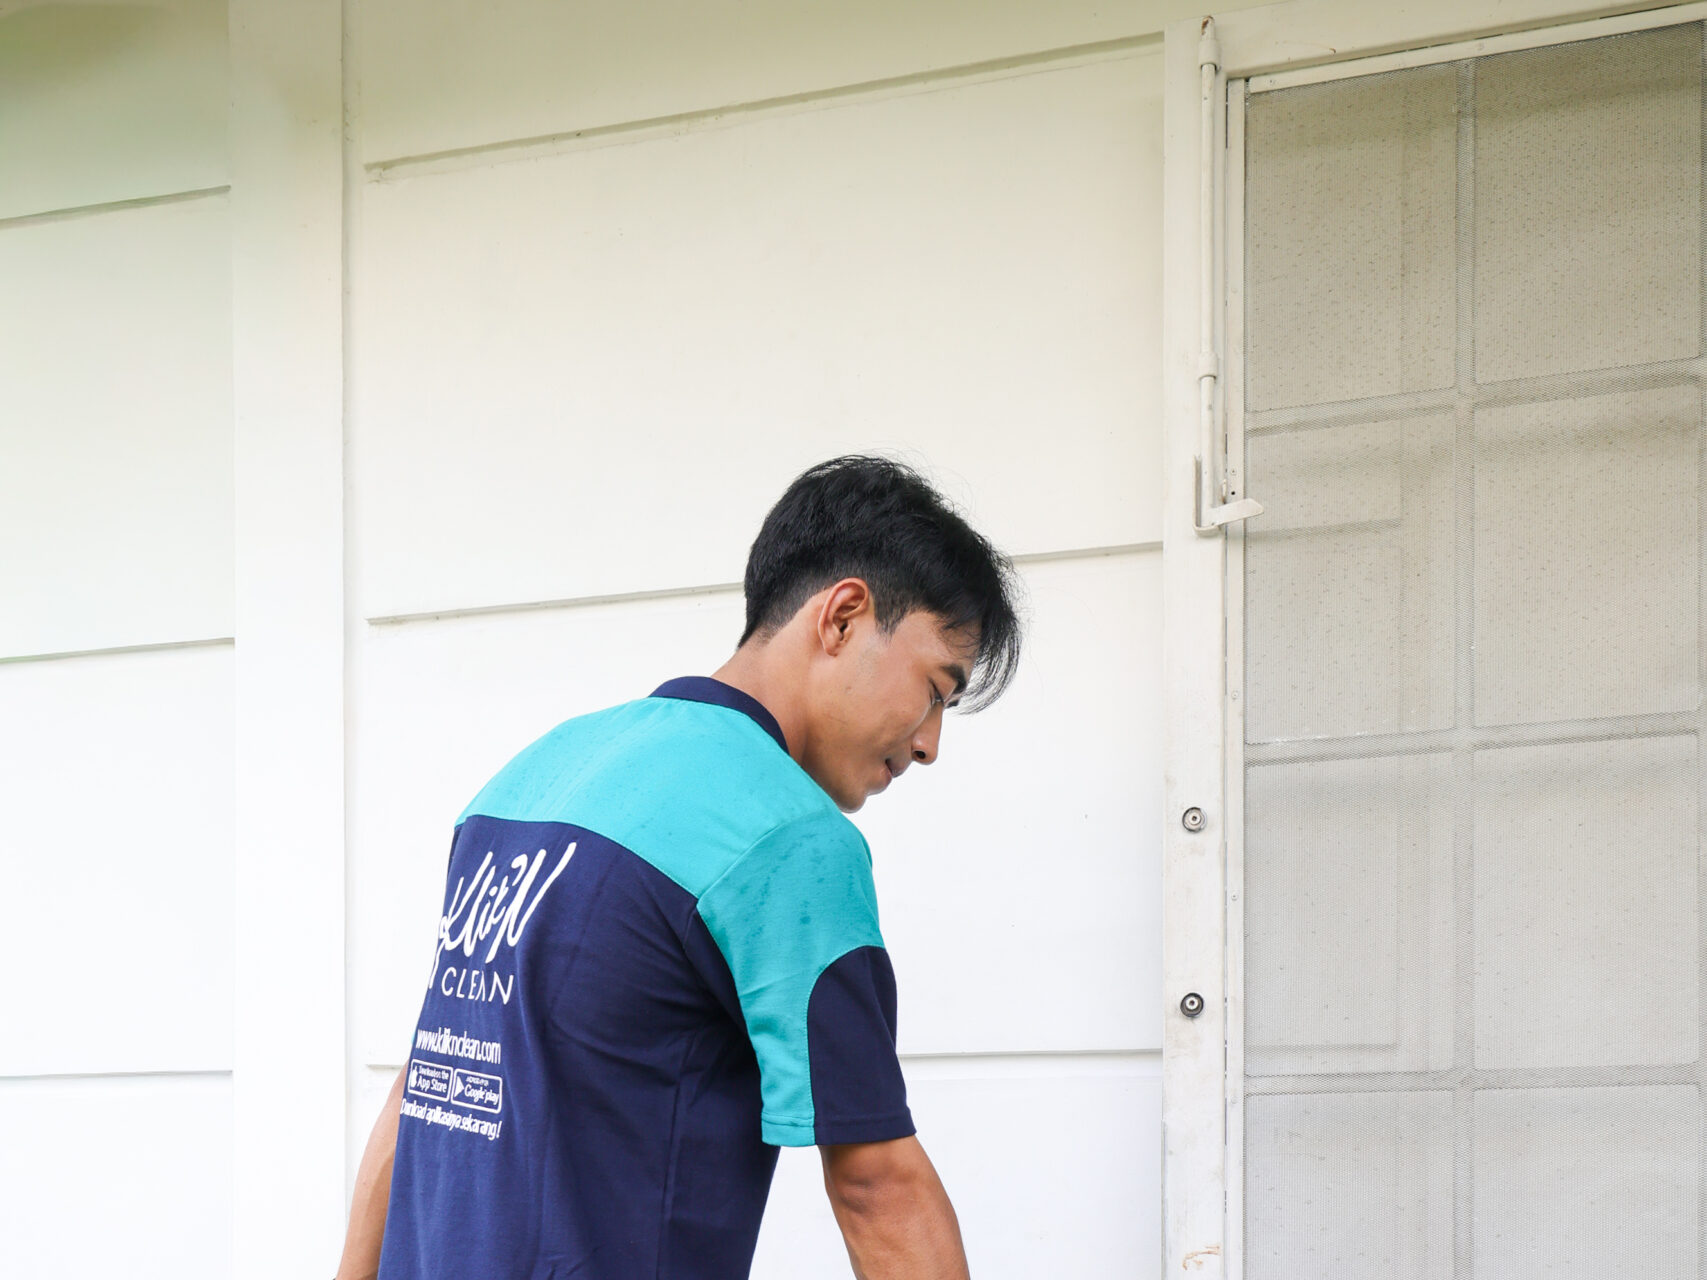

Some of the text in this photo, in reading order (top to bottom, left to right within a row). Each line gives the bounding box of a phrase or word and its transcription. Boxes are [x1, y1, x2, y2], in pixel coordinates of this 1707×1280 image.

[441, 966, 514, 1005] CLEAN
[416, 1026, 502, 1065] www.kliknclean.com
[417, 1075, 431, 1092] App
[431, 1078, 447, 1093] Store
[464, 1083, 485, 1103] Google
